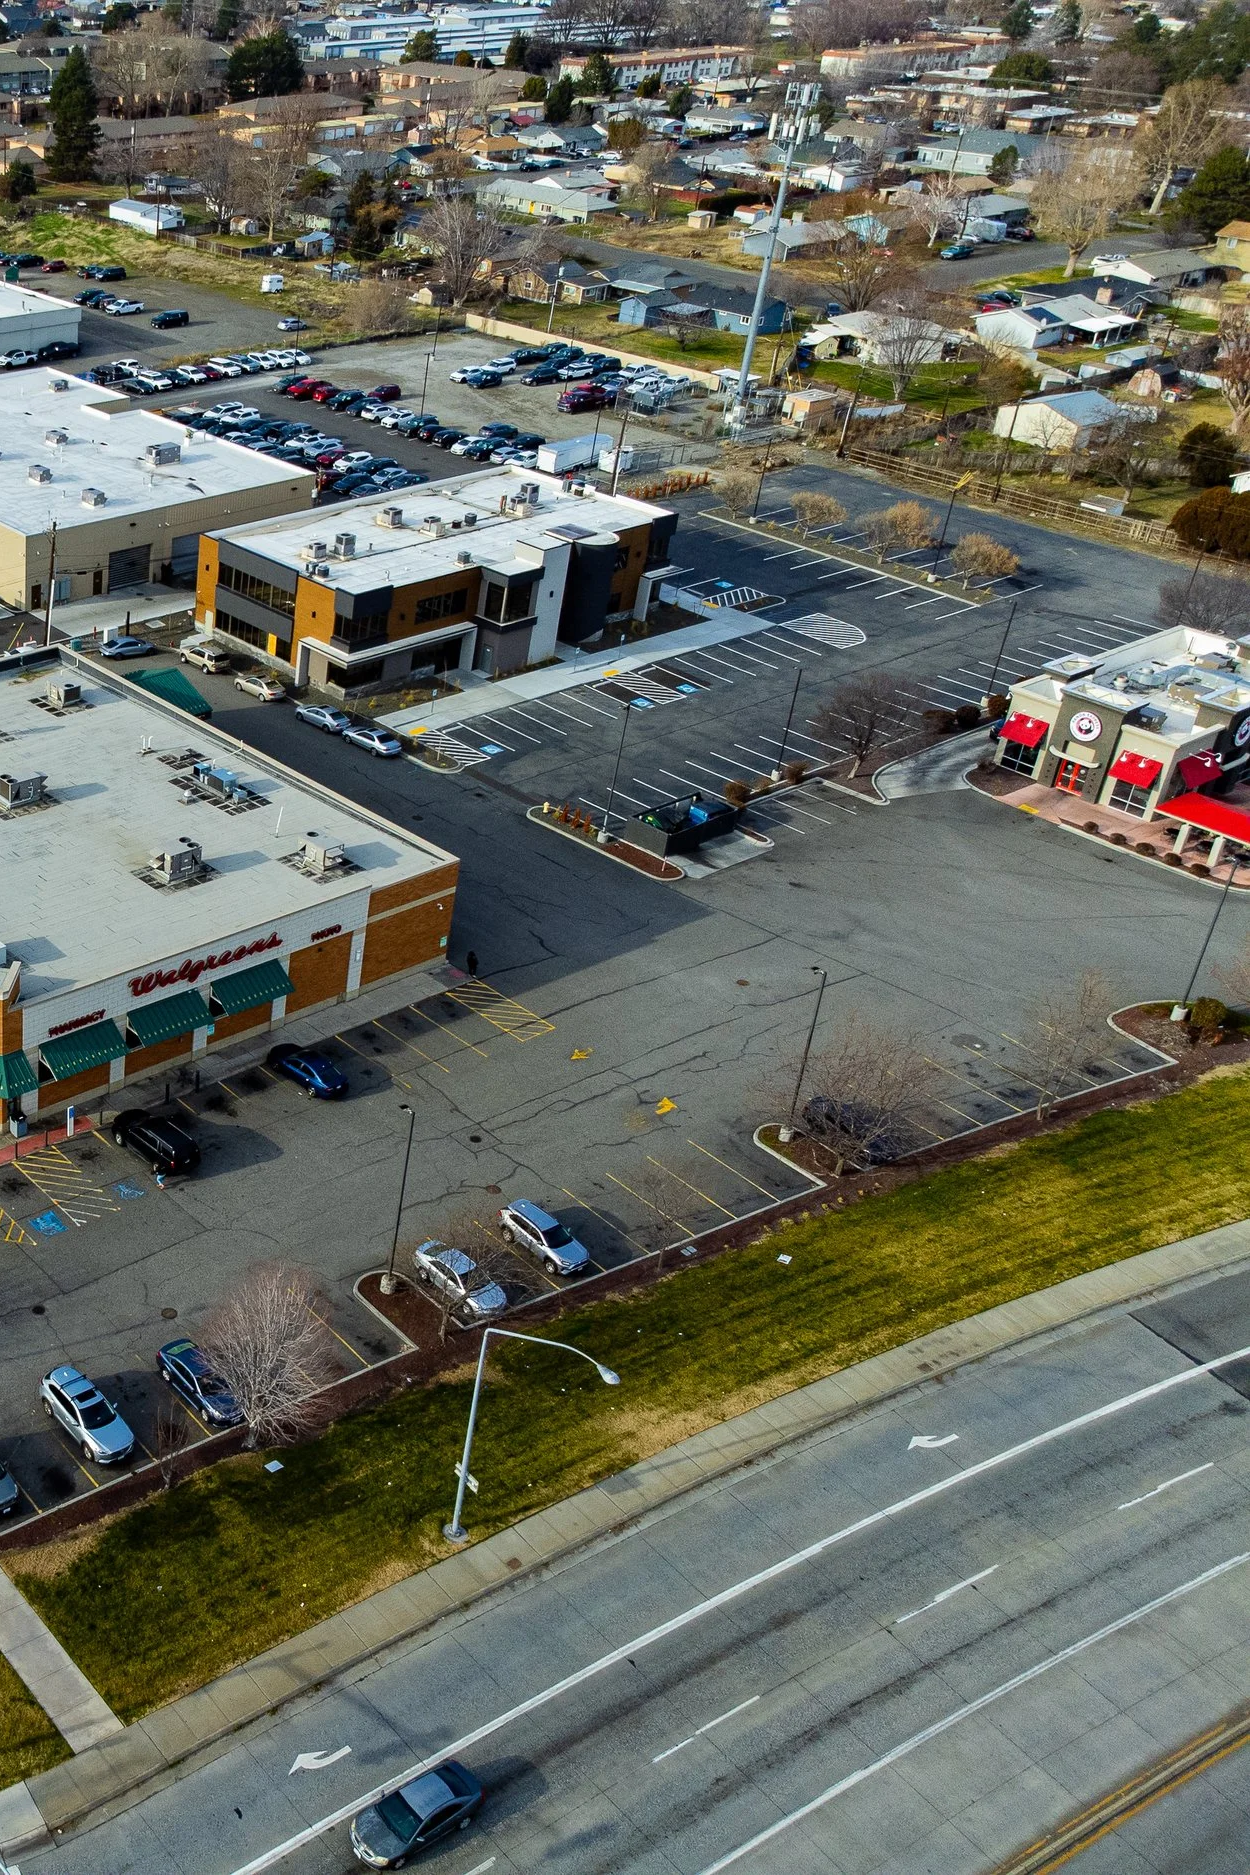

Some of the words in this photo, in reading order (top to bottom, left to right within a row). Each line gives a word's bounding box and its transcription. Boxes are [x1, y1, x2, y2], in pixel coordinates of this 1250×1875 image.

[310, 924, 342, 942] PHOTO
[128, 931, 284, 997] Walgreens
[48, 1008, 107, 1038] PHARMACY
